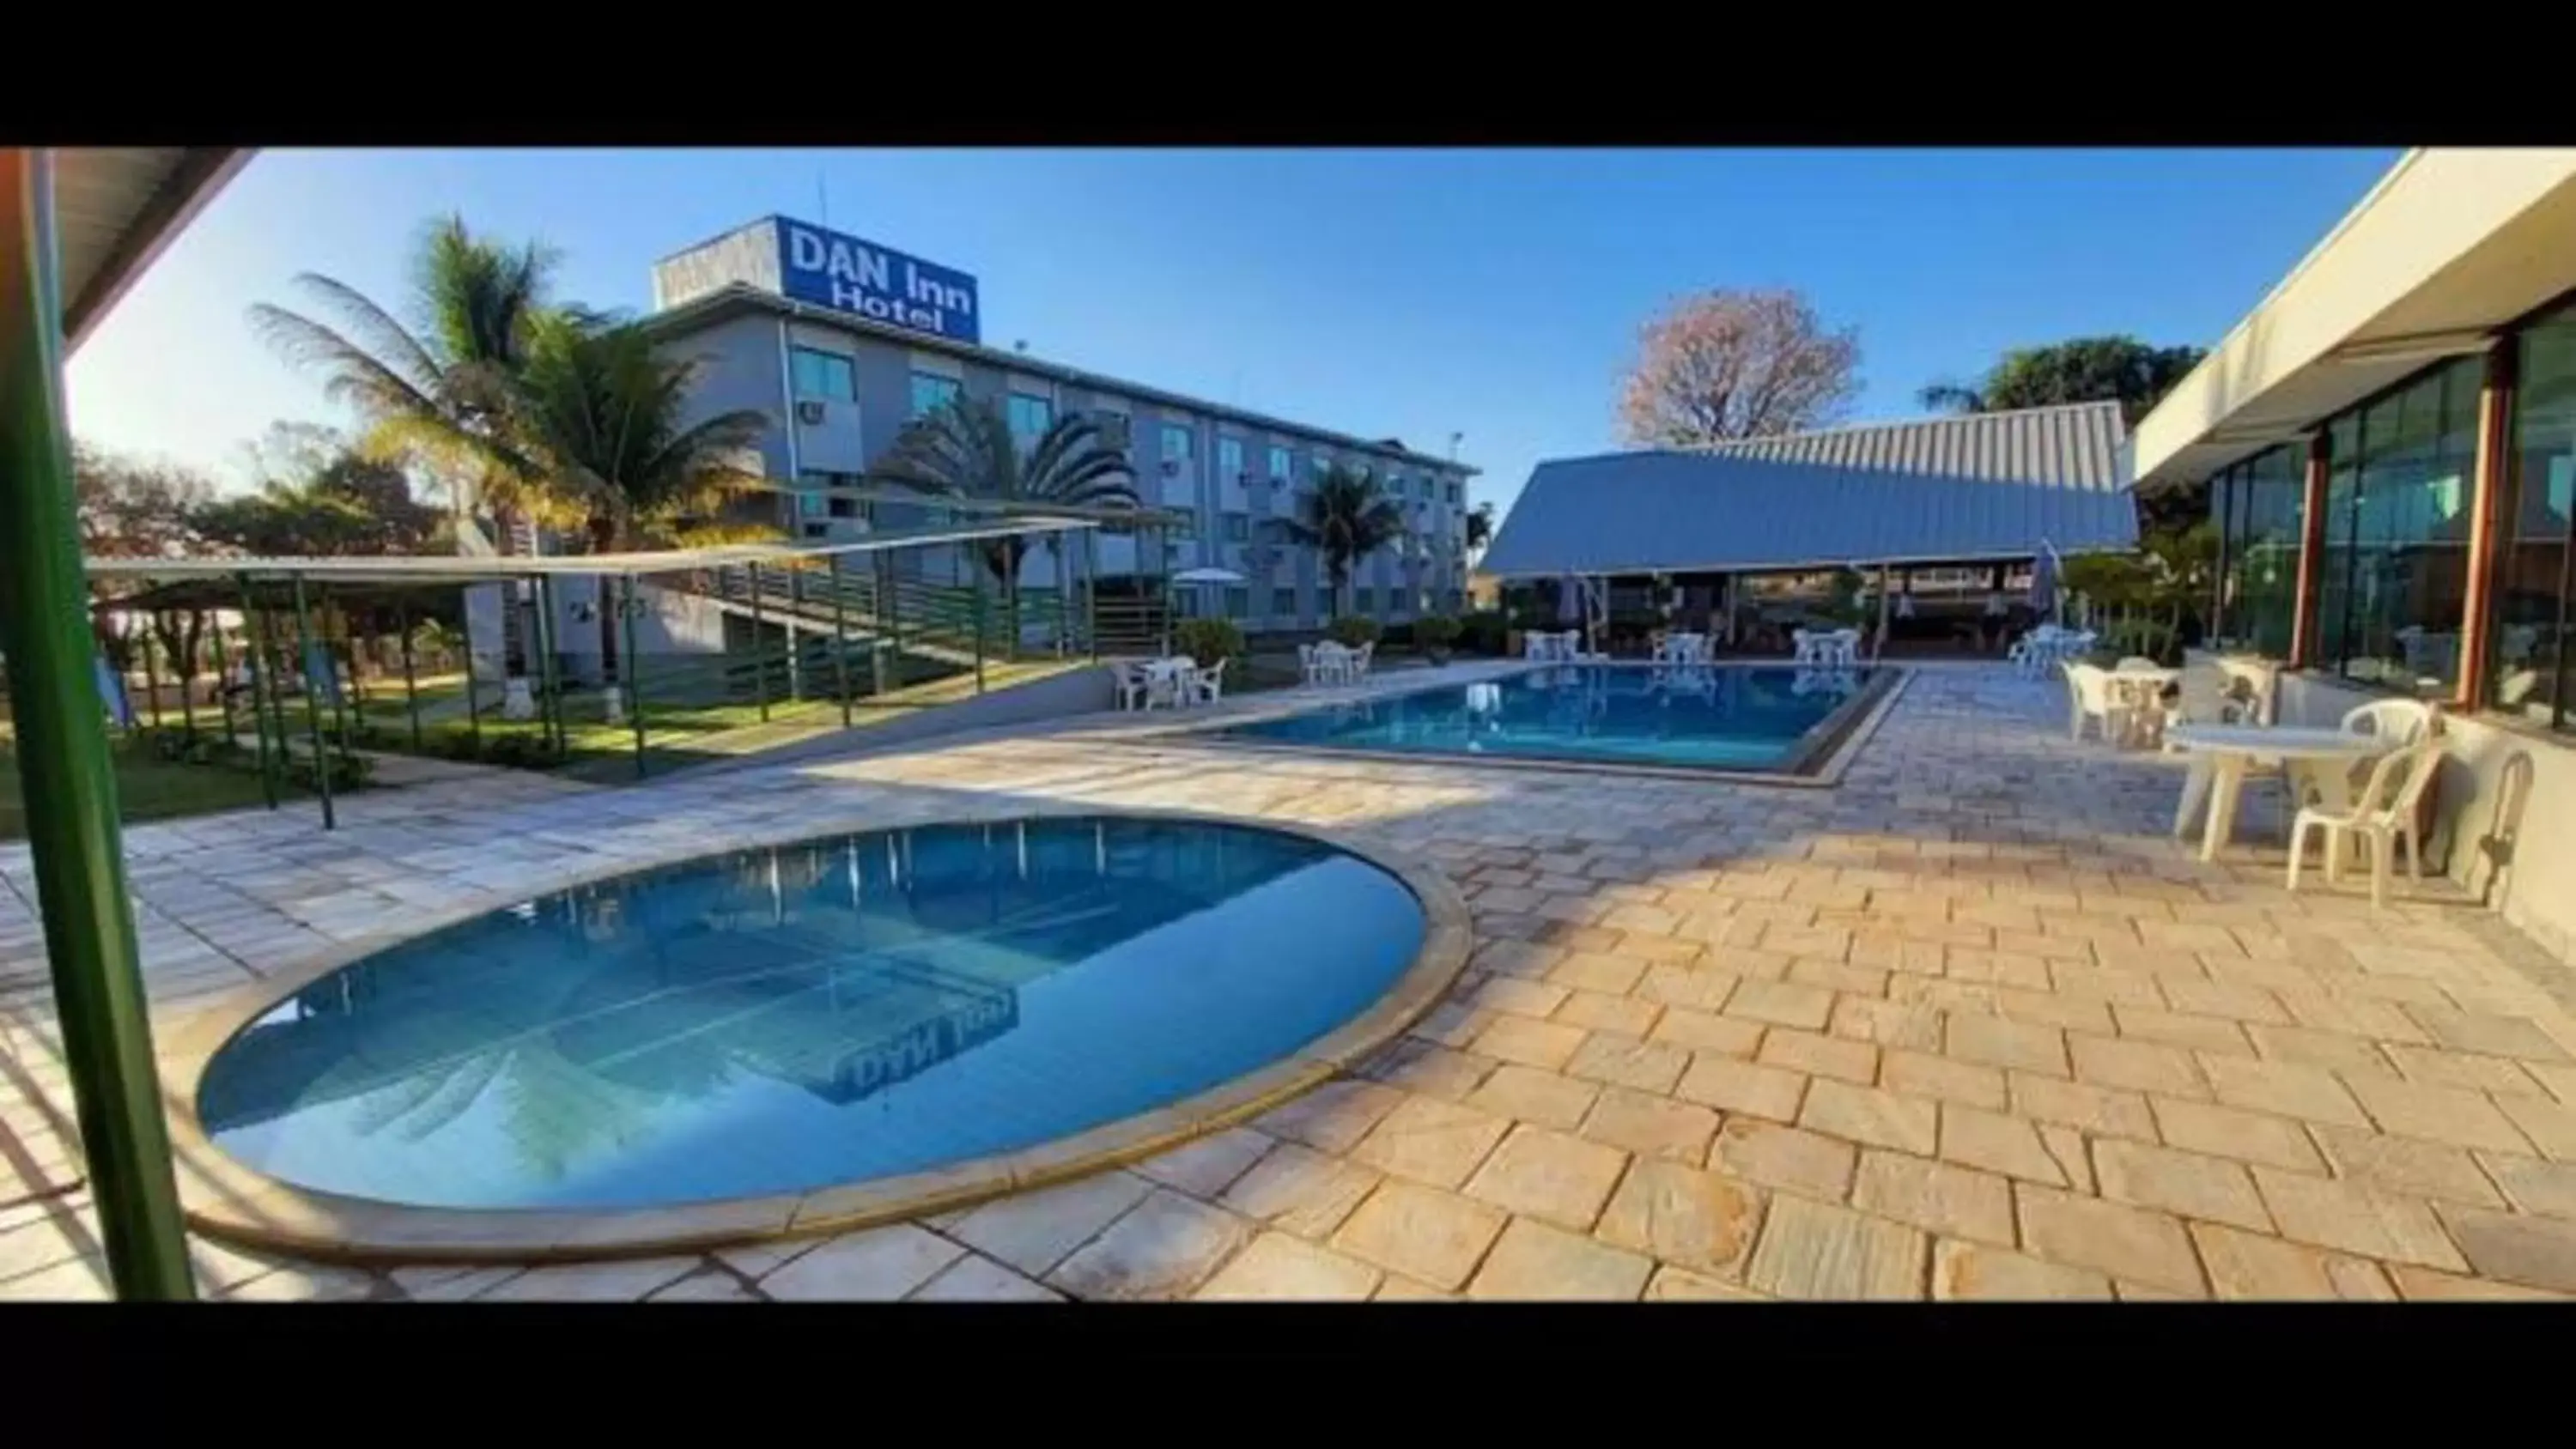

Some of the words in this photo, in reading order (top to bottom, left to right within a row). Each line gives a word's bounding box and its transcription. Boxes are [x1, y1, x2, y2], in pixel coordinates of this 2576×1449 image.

[790, 227, 888, 292] DAN
[906, 262, 971, 315] Inn
[831, 282, 944, 333] Hotel
